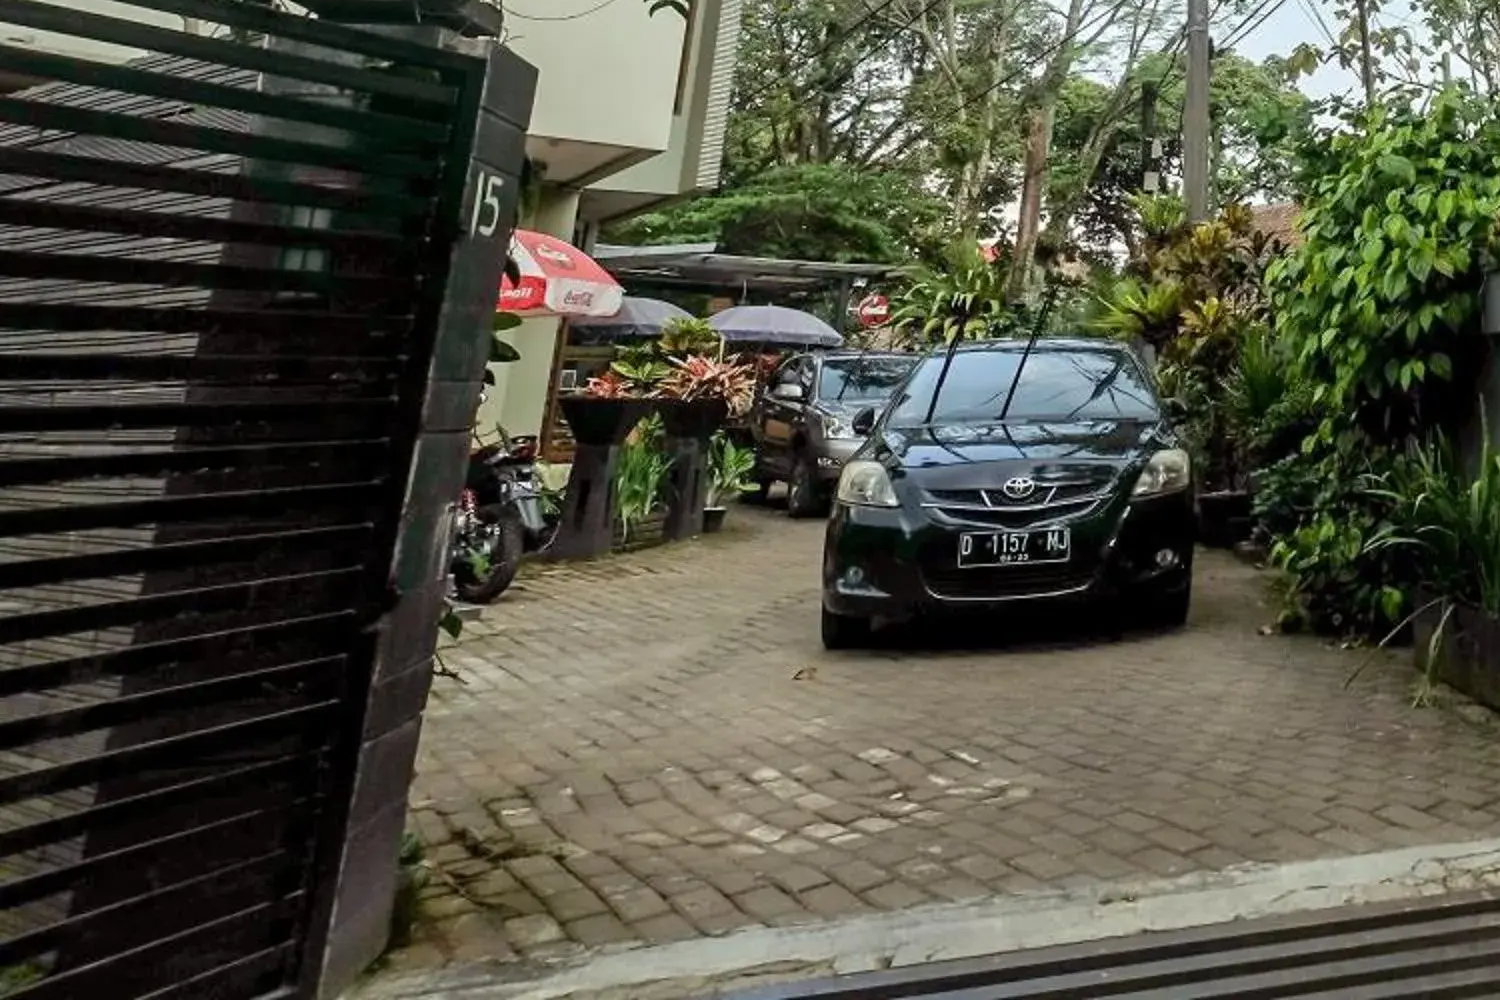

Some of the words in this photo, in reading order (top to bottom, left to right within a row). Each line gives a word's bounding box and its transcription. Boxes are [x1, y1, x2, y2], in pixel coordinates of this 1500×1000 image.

[471, 171, 503, 237] 15
[961, 535, 973, 555] D
[992, 532, 1029, 555] 1157
